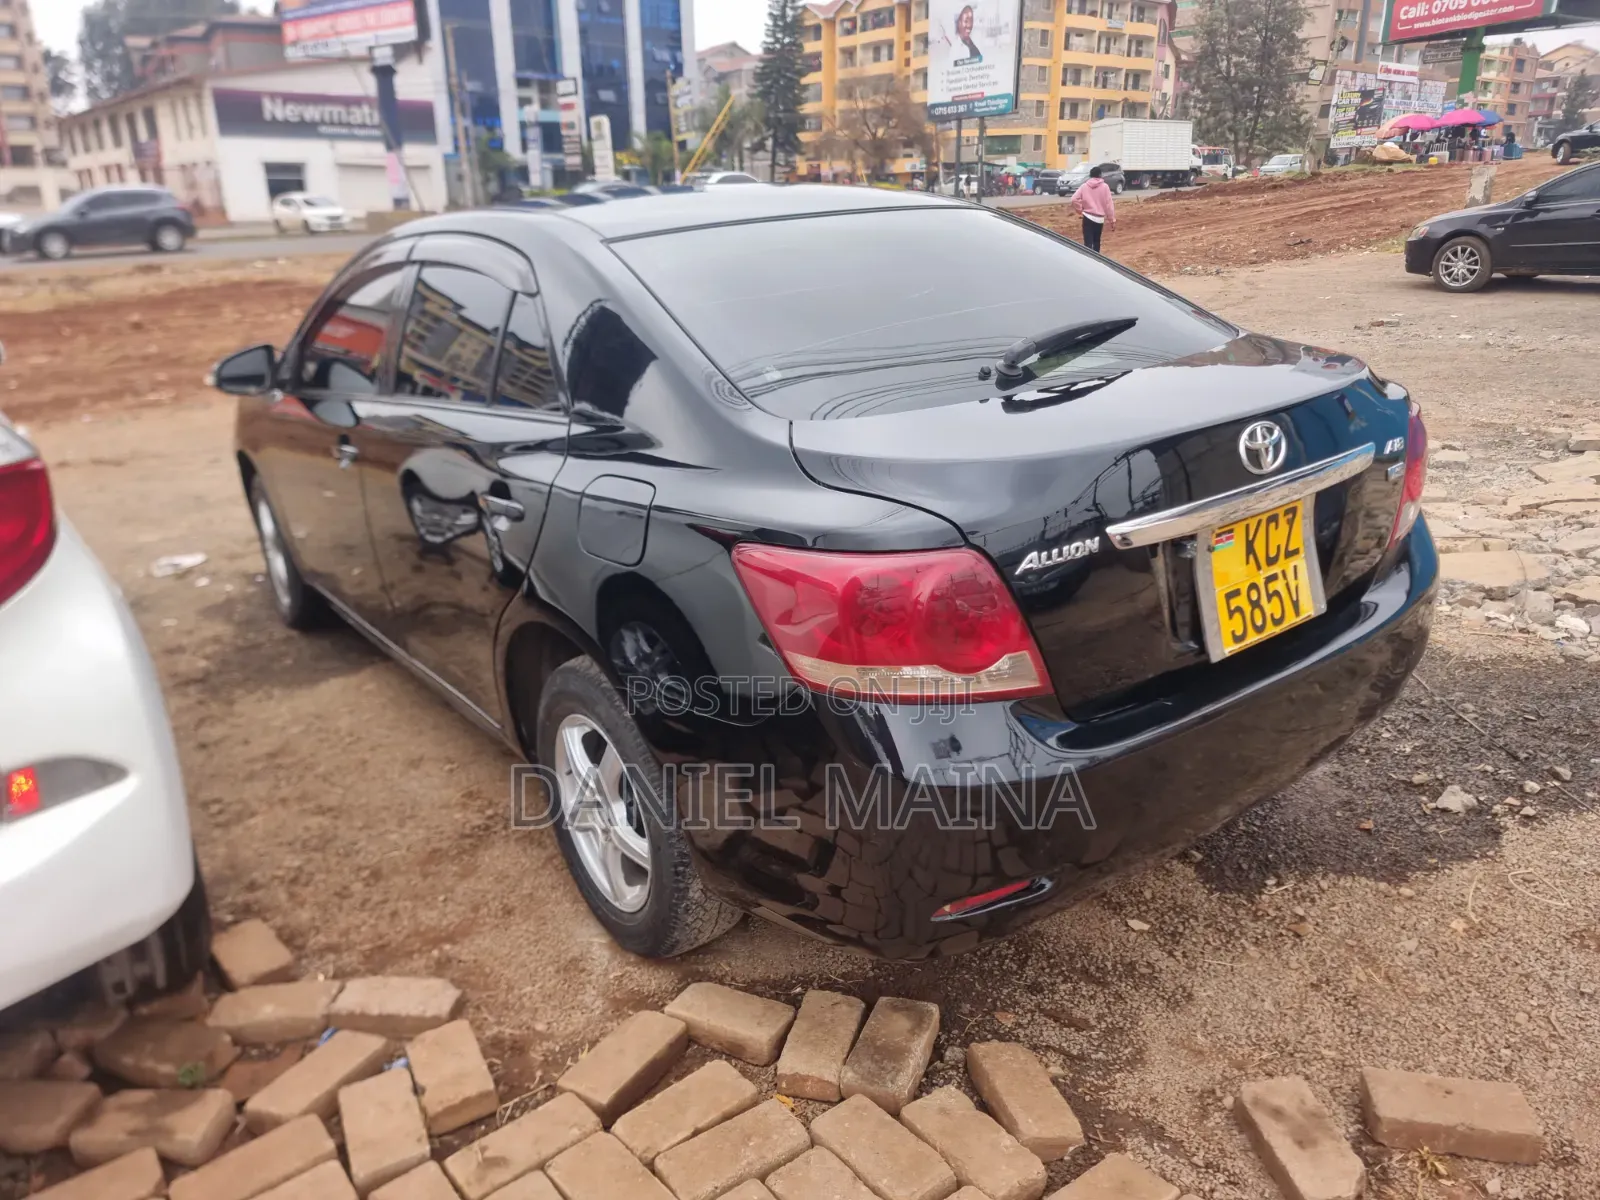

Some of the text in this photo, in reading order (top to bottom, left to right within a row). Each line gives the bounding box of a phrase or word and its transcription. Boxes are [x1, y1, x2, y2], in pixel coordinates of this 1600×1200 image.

[1400, 3, 1429, 19] Call:
[1414, 5, 1514, 28] www.biotankbiodigester.com
[1015, 536, 1100, 575] ALLION
[1245, 506, 1300, 571] KCZ
[1224, 564, 1300, 644] 585V
